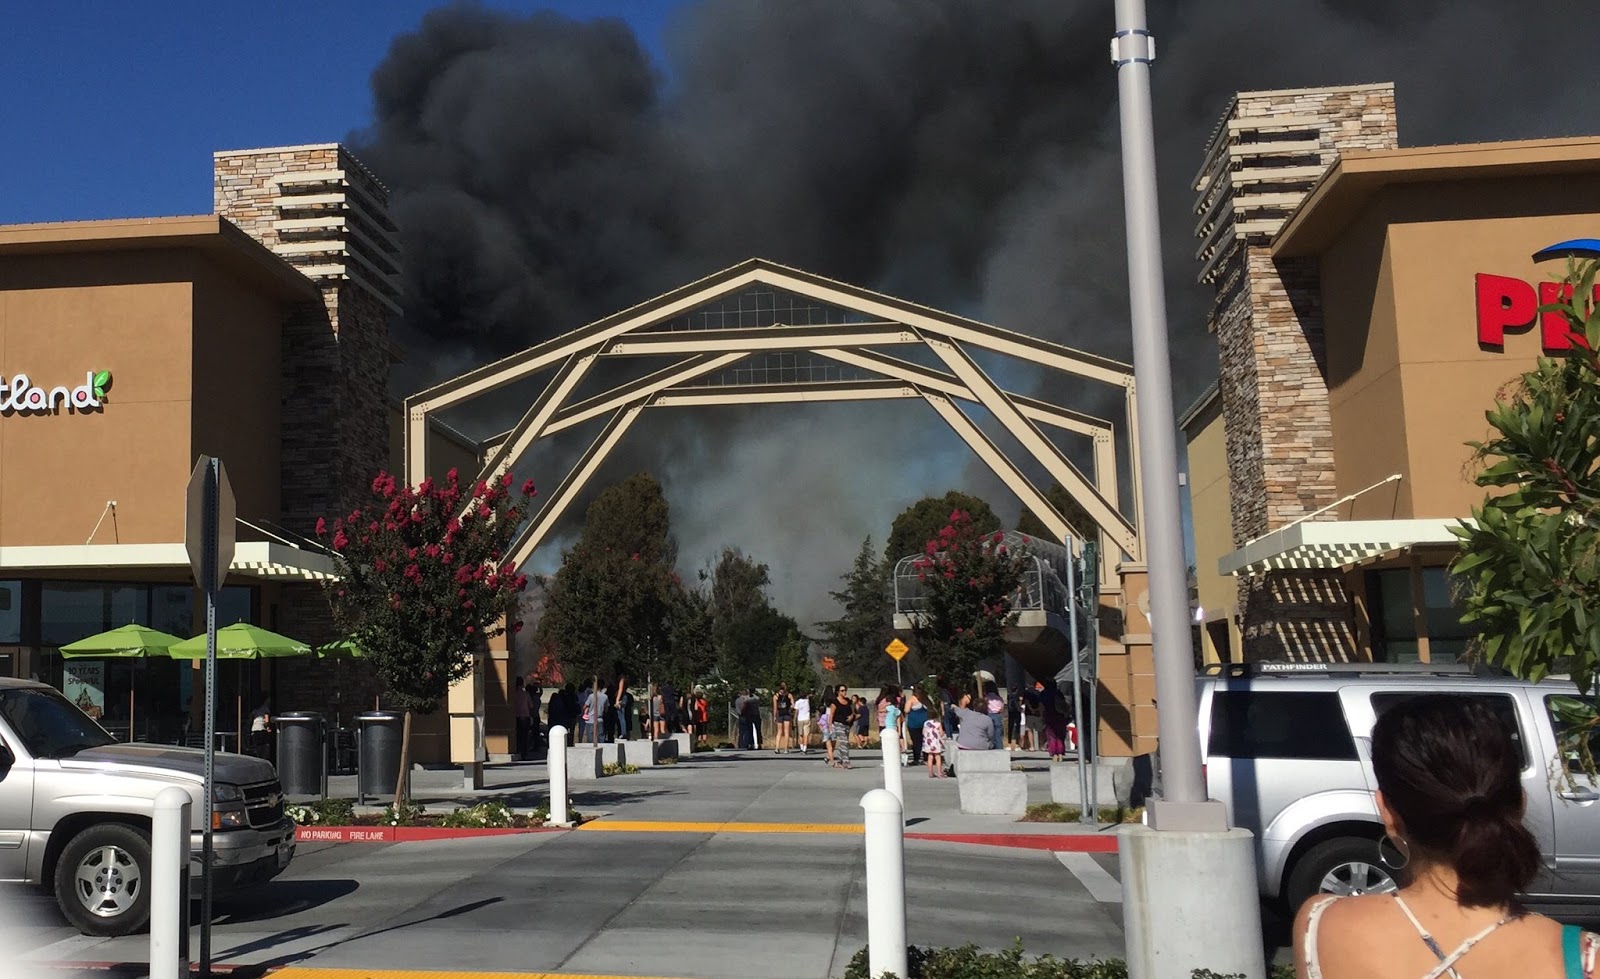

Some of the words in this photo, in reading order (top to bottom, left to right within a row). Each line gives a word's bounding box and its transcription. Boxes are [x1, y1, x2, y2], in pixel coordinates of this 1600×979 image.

[78, 667, 101, 675] YEARS
[1262, 663, 1328, 671] PATHFINDER
[301, 831, 311, 839] NO
[312, 831, 342, 840] PARKING
[349, 831, 365, 840] FIRE
[365, 831, 384, 840] LANE
